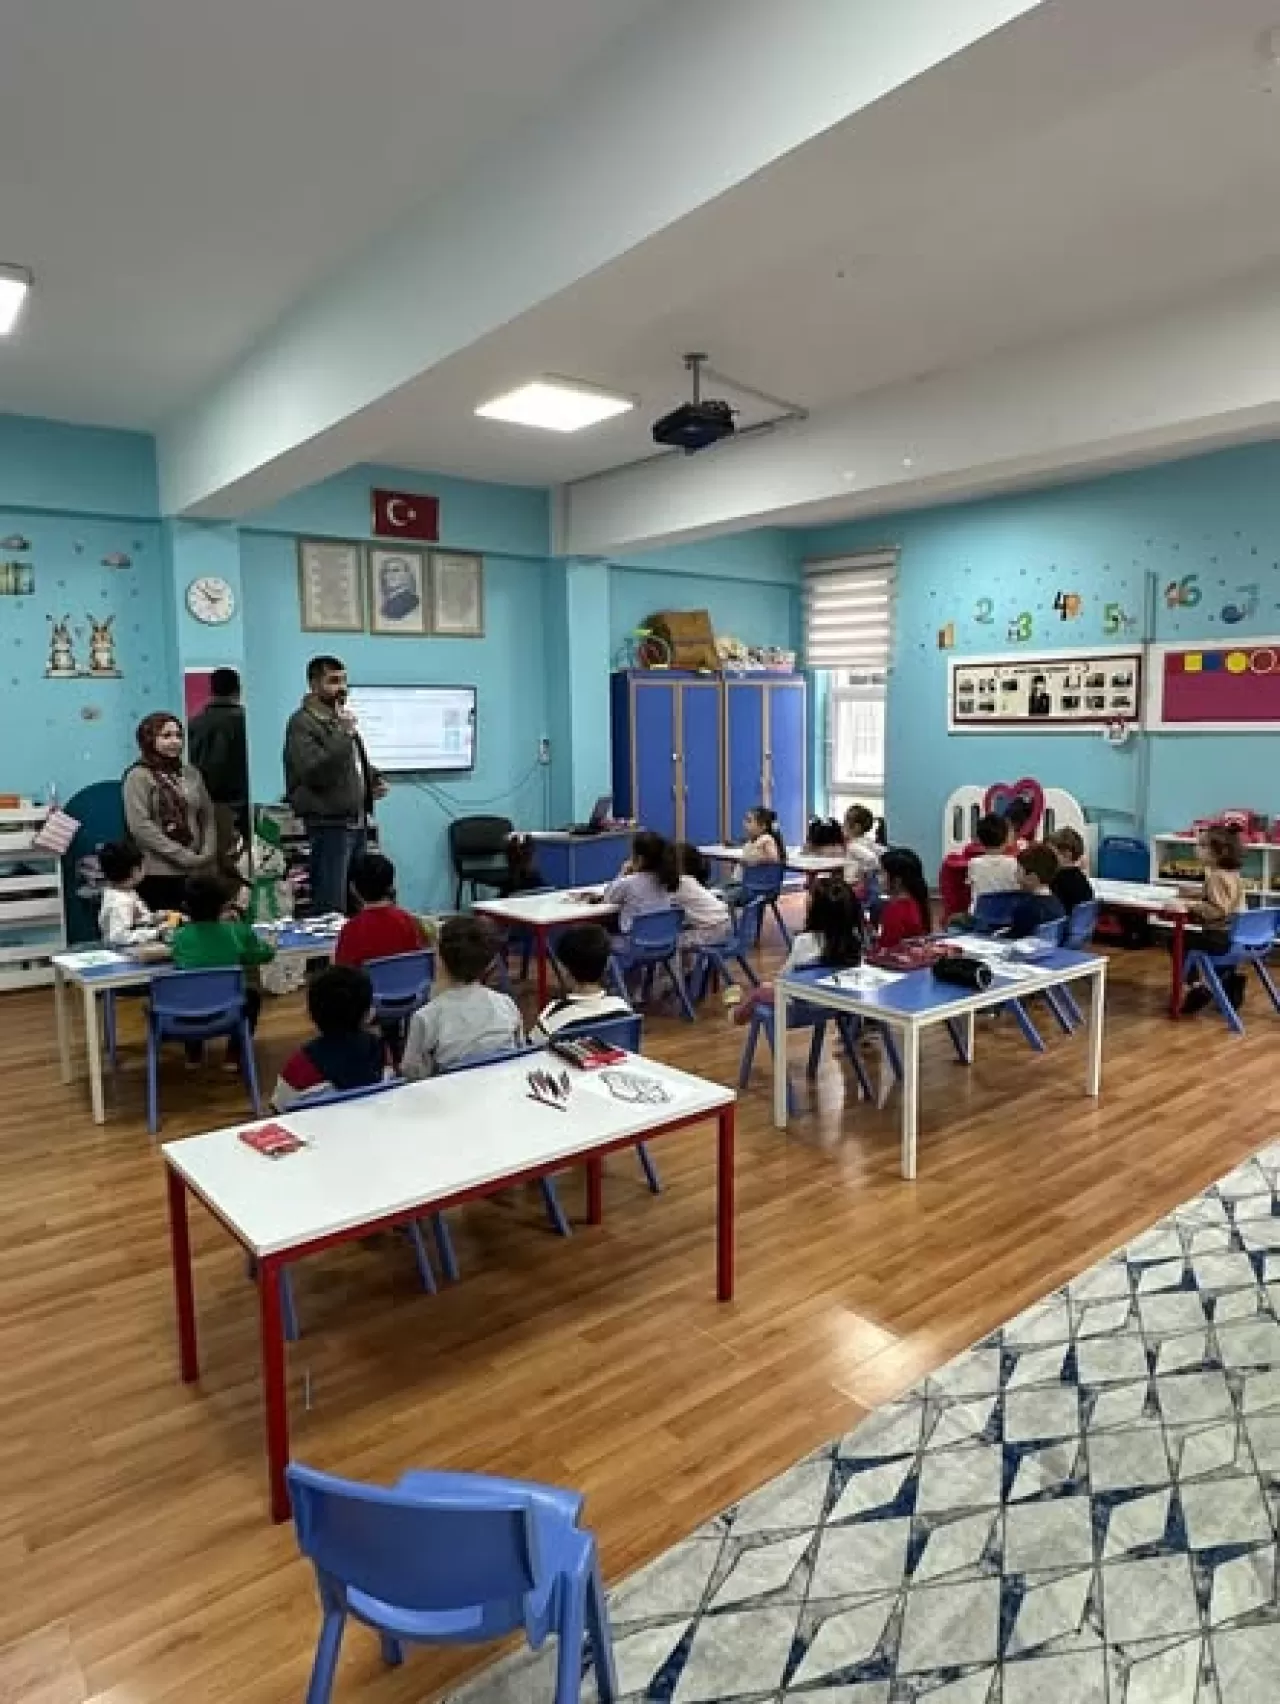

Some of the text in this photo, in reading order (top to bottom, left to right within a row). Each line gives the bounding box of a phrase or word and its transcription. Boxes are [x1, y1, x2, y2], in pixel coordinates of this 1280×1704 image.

[975, 597, 994, 624] 2
[1017, 612, 1032, 641] 3
[1104, 603, 1120, 633] 5
[1179, 574, 1202, 607] 6
